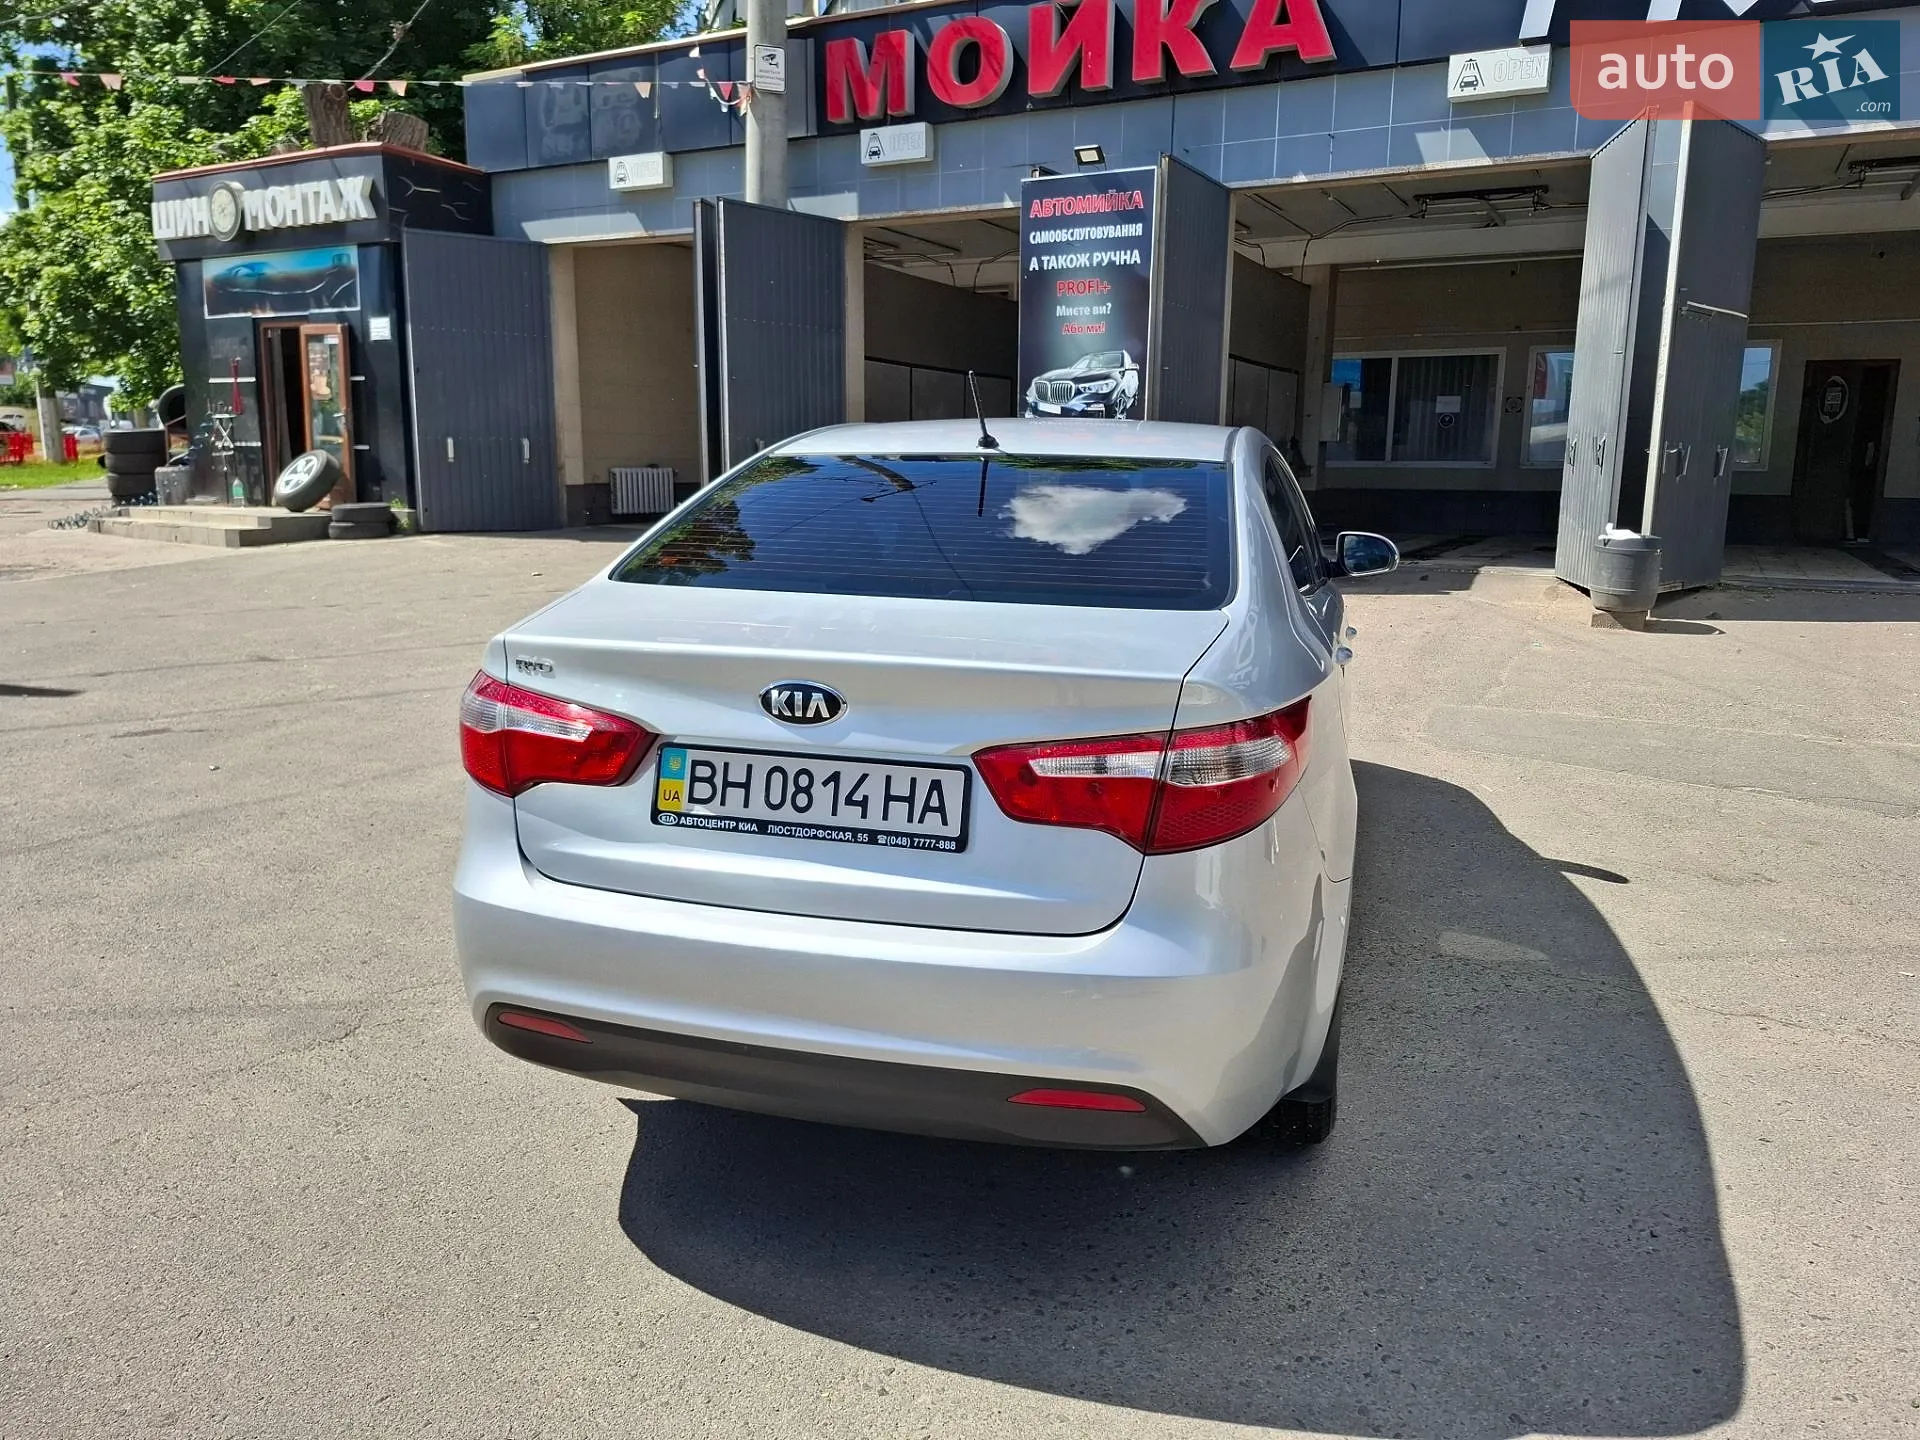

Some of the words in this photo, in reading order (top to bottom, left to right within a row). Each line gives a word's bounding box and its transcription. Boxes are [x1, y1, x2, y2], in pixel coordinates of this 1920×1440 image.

[1493, 55, 1546, 82] OPEN
[1029, 189, 1144, 219] АВТОМИЙКА
[1029, 223, 1143, 245] САМООБСЛУГОВУВАННЯ
[1029, 256, 1039, 271] А
[1041, 252, 1090, 270] ТАКОЖ
[1093, 249, 1141, 268] РУЧНА
[1056, 278, 1111, 297] PROFI+
[1092, 302, 1112, 316] ви?
[770, 689, 830, 718] KIA
[663, 789, 681, 802] UA
[763, 765, 870, 820] 0814
[679, 816, 736, 829] АВТОЦЕНТР
[738, 822, 758, 832] КИА
[767, 824, 855, 842] ЛЮСТДОРФСКАЯ,
[857, 833, 869, 842] 55
[913, 837, 956, 850] 7777-888
